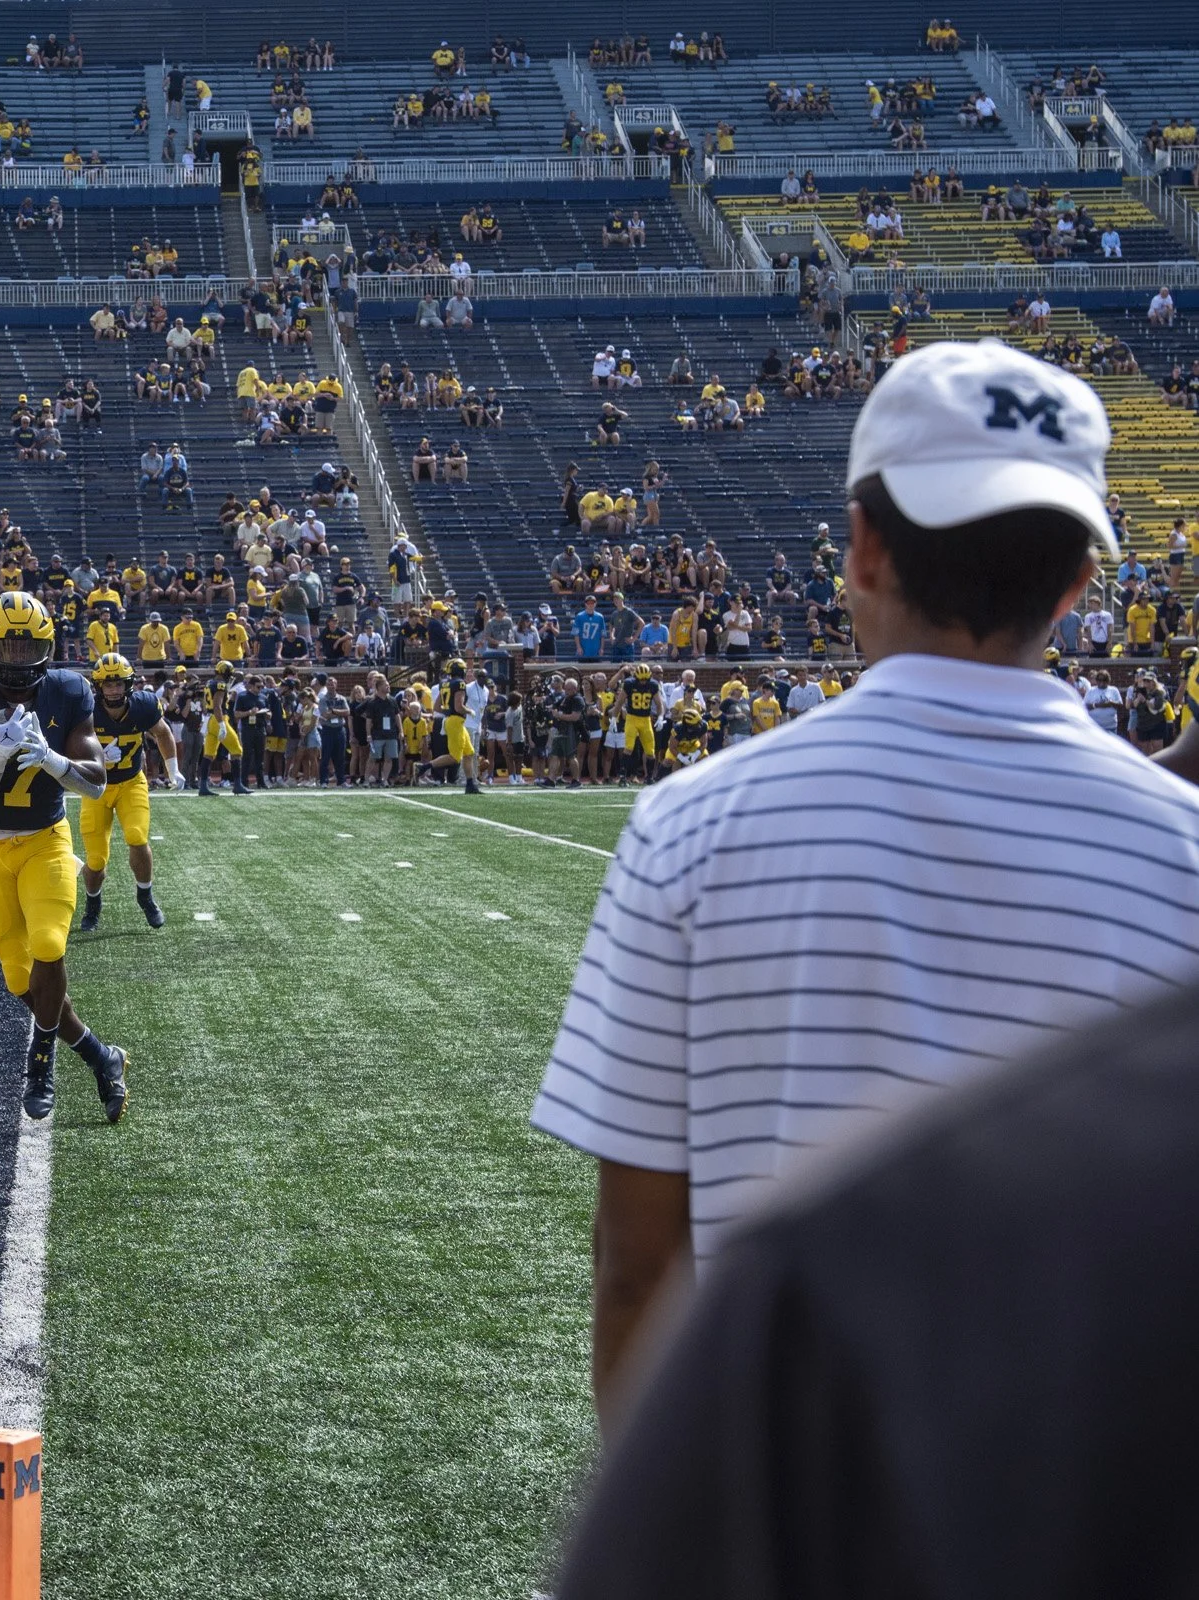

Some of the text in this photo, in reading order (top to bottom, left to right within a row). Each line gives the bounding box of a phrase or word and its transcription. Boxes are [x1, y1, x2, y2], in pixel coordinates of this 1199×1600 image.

[636, 111, 651, 120] 43
[771, 225, 786, 234] 43
[302, 234, 317, 243] 42
[984, 384, 1066, 443] M
[5, 576, 18, 586] M
[185, 572, 195, 581] M
[214, 574, 223, 583] M
[582, 622, 599, 640] 97
[191, 701, 202, 712] M
[708, 720, 721, 730] M
[412, 727, 417, 740] 1
[14, 1454, 41, 1499] M
